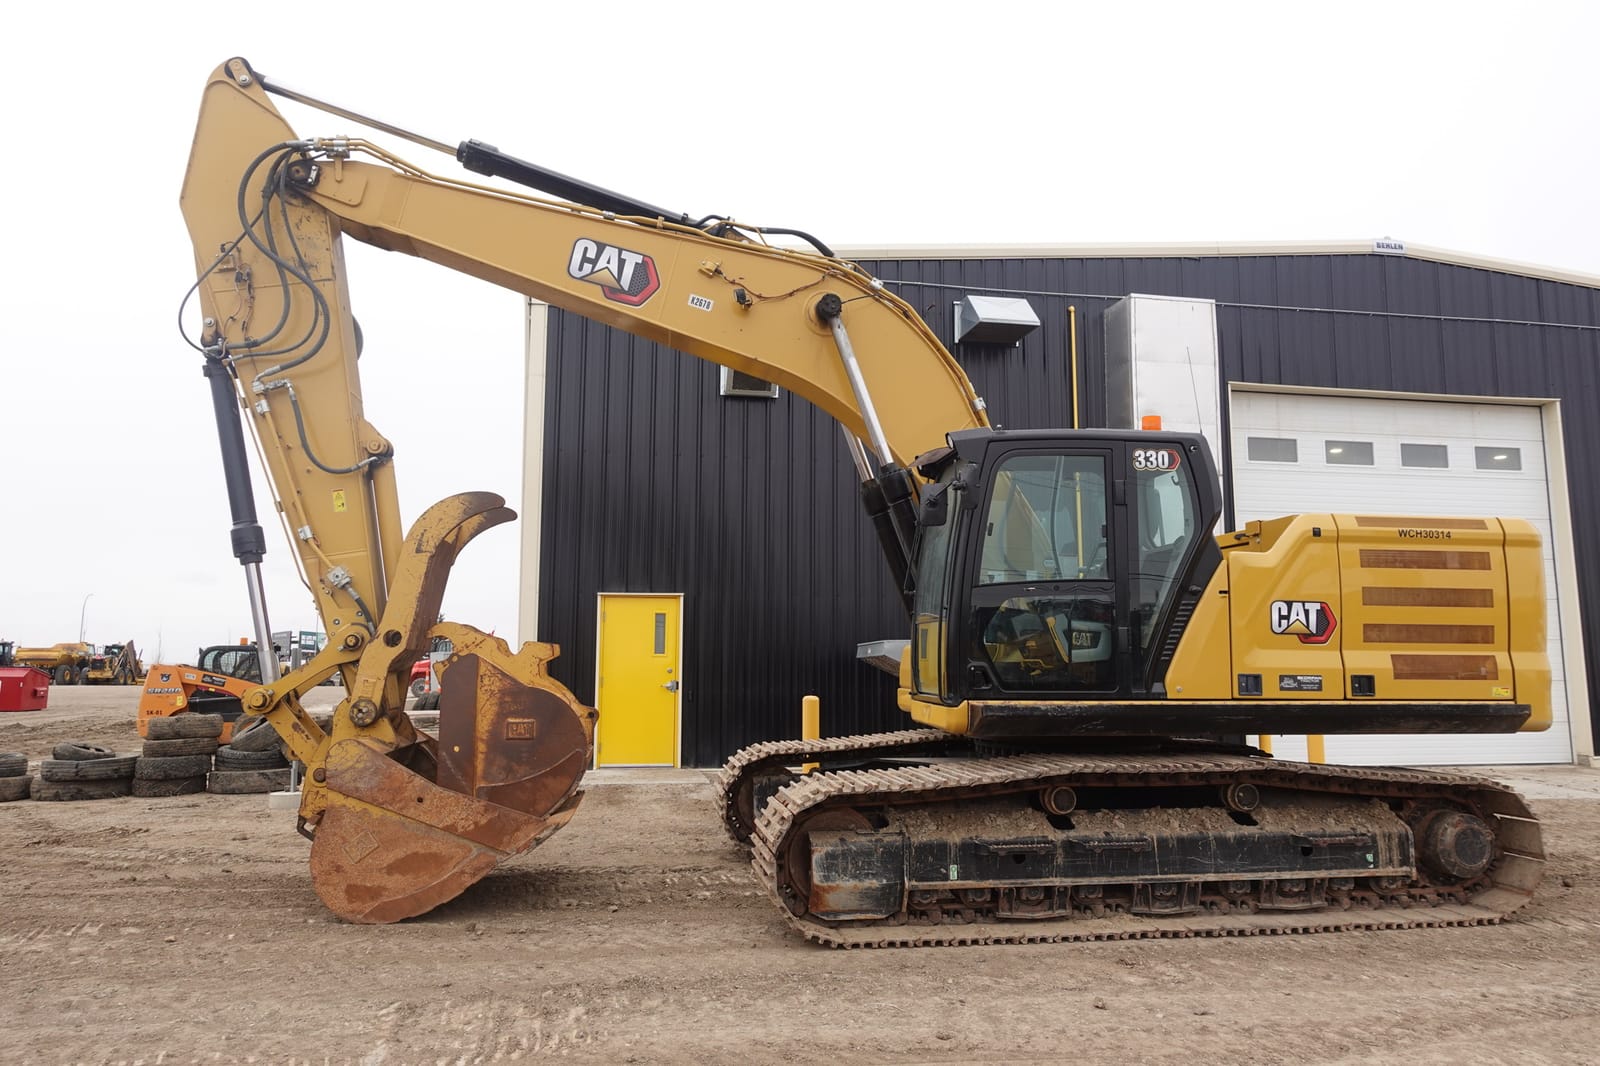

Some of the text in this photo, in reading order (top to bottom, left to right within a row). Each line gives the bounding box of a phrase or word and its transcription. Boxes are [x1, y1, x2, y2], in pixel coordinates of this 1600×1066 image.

[1376, 242, 1404, 250] BEHLEN
[568, 239, 644, 292] CAT
[1134, 450, 1169, 469] 330
[1398, 529, 1452, 539] WCH30314
[1271, 601, 1321, 634] CAT
[1072, 632, 1093, 646] CAT
